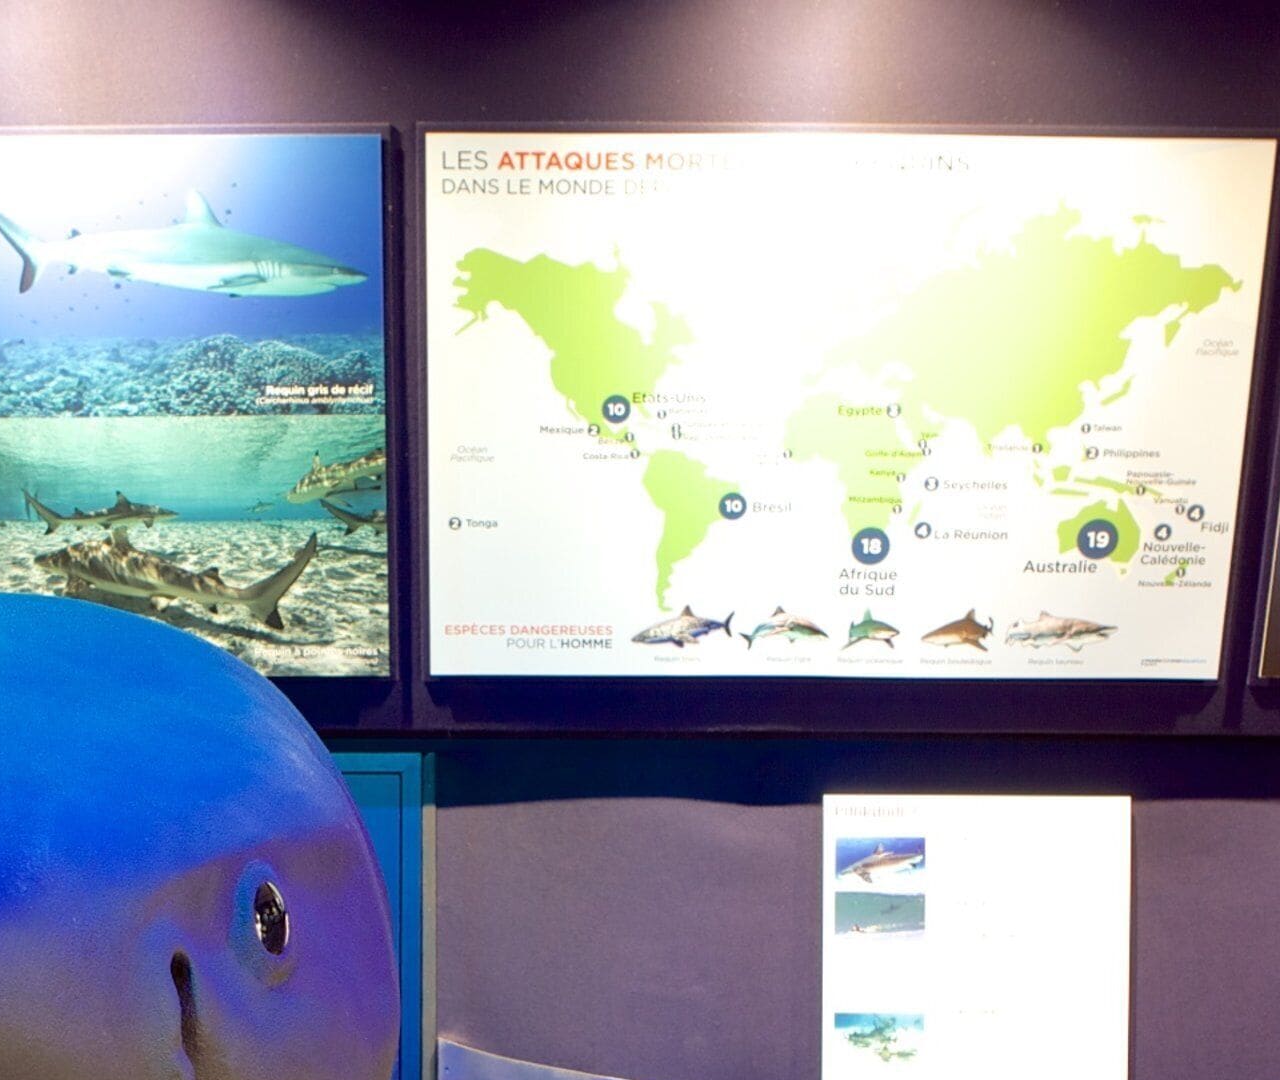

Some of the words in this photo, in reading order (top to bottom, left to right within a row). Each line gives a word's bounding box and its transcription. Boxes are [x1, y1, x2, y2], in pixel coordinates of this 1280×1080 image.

[442, 150, 488, 170] LES
[497, 151, 635, 171] ATTAQUES
[442, 178, 500, 195] DANS
[506, 178, 531, 195] LE
[538, 178, 615, 195] MONDE
[331, 385, 345, 394] de
[607, 403, 626, 416] 10
[540, 425, 584, 434] Mexique
[725, 499, 743, 513] 10
[466, 519, 498, 529] Tonga
[1201, 521, 1229, 534] Fidji
[860, 537, 882, 555] 18
[1087, 531, 1110, 548] 19
[1023, 560, 1098, 573] Australie
[839, 568, 898, 581] Afrique
[839, 584, 859, 596] du
[865, 584, 895, 596] Sud
[444, 623, 506, 636] ESPÈCES
[510, 625, 613, 636] DANGEREUSES
[506, 637, 545, 649] POUR
[550, 638, 613, 649] L'HOMME
